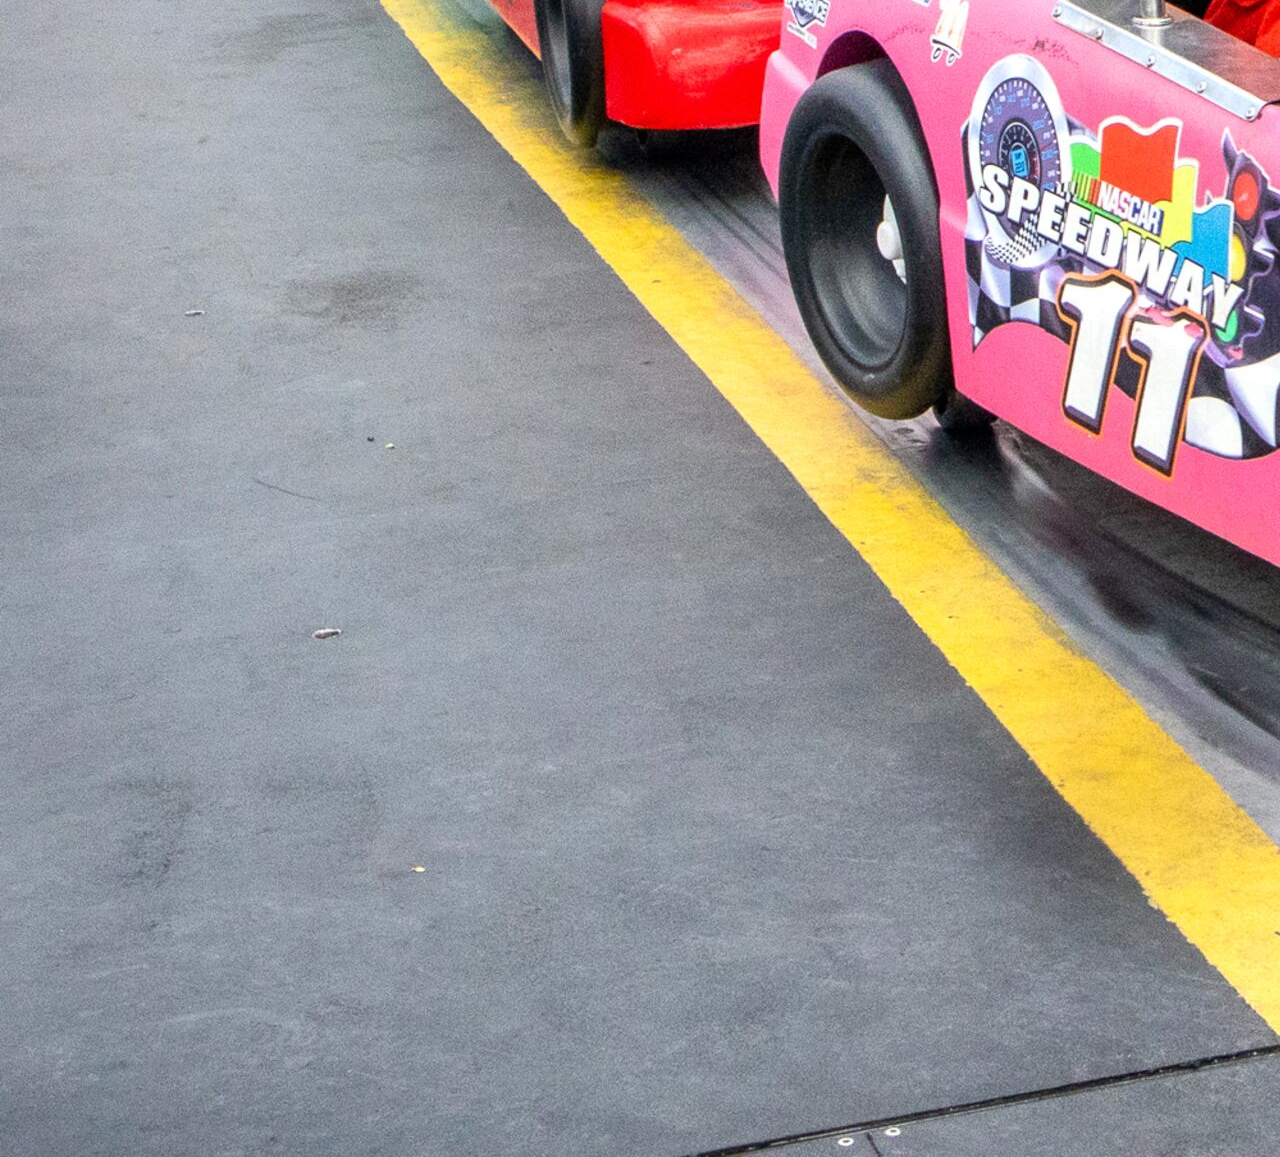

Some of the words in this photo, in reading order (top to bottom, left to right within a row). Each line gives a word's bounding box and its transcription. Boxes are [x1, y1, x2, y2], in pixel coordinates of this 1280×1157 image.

[980, 163, 1244, 329] SPEEDWAY
[1097, 182, 1163, 235] NASCAR
[1058, 270, 1209, 477] 11
